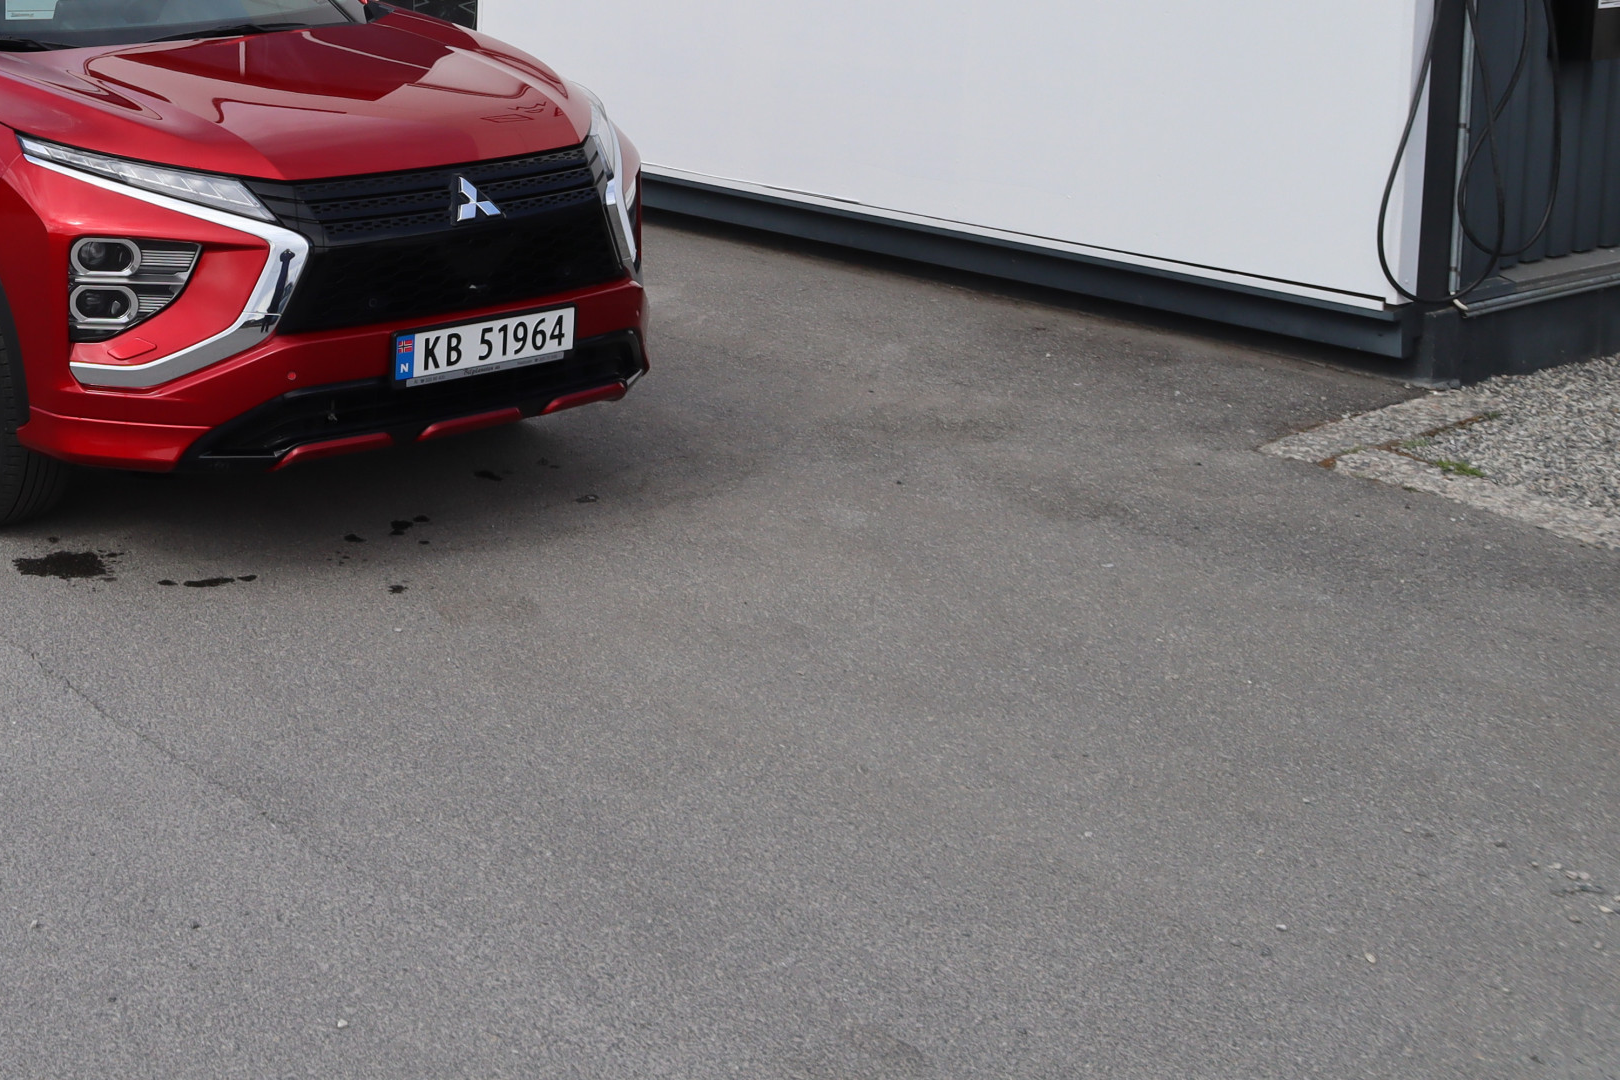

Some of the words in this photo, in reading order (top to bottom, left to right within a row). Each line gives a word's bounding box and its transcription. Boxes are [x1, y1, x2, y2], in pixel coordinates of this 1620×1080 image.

[423, 332, 462, 371] KB
[478, 315, 565, 361] 51964
[400, 363, 409, 374] N
